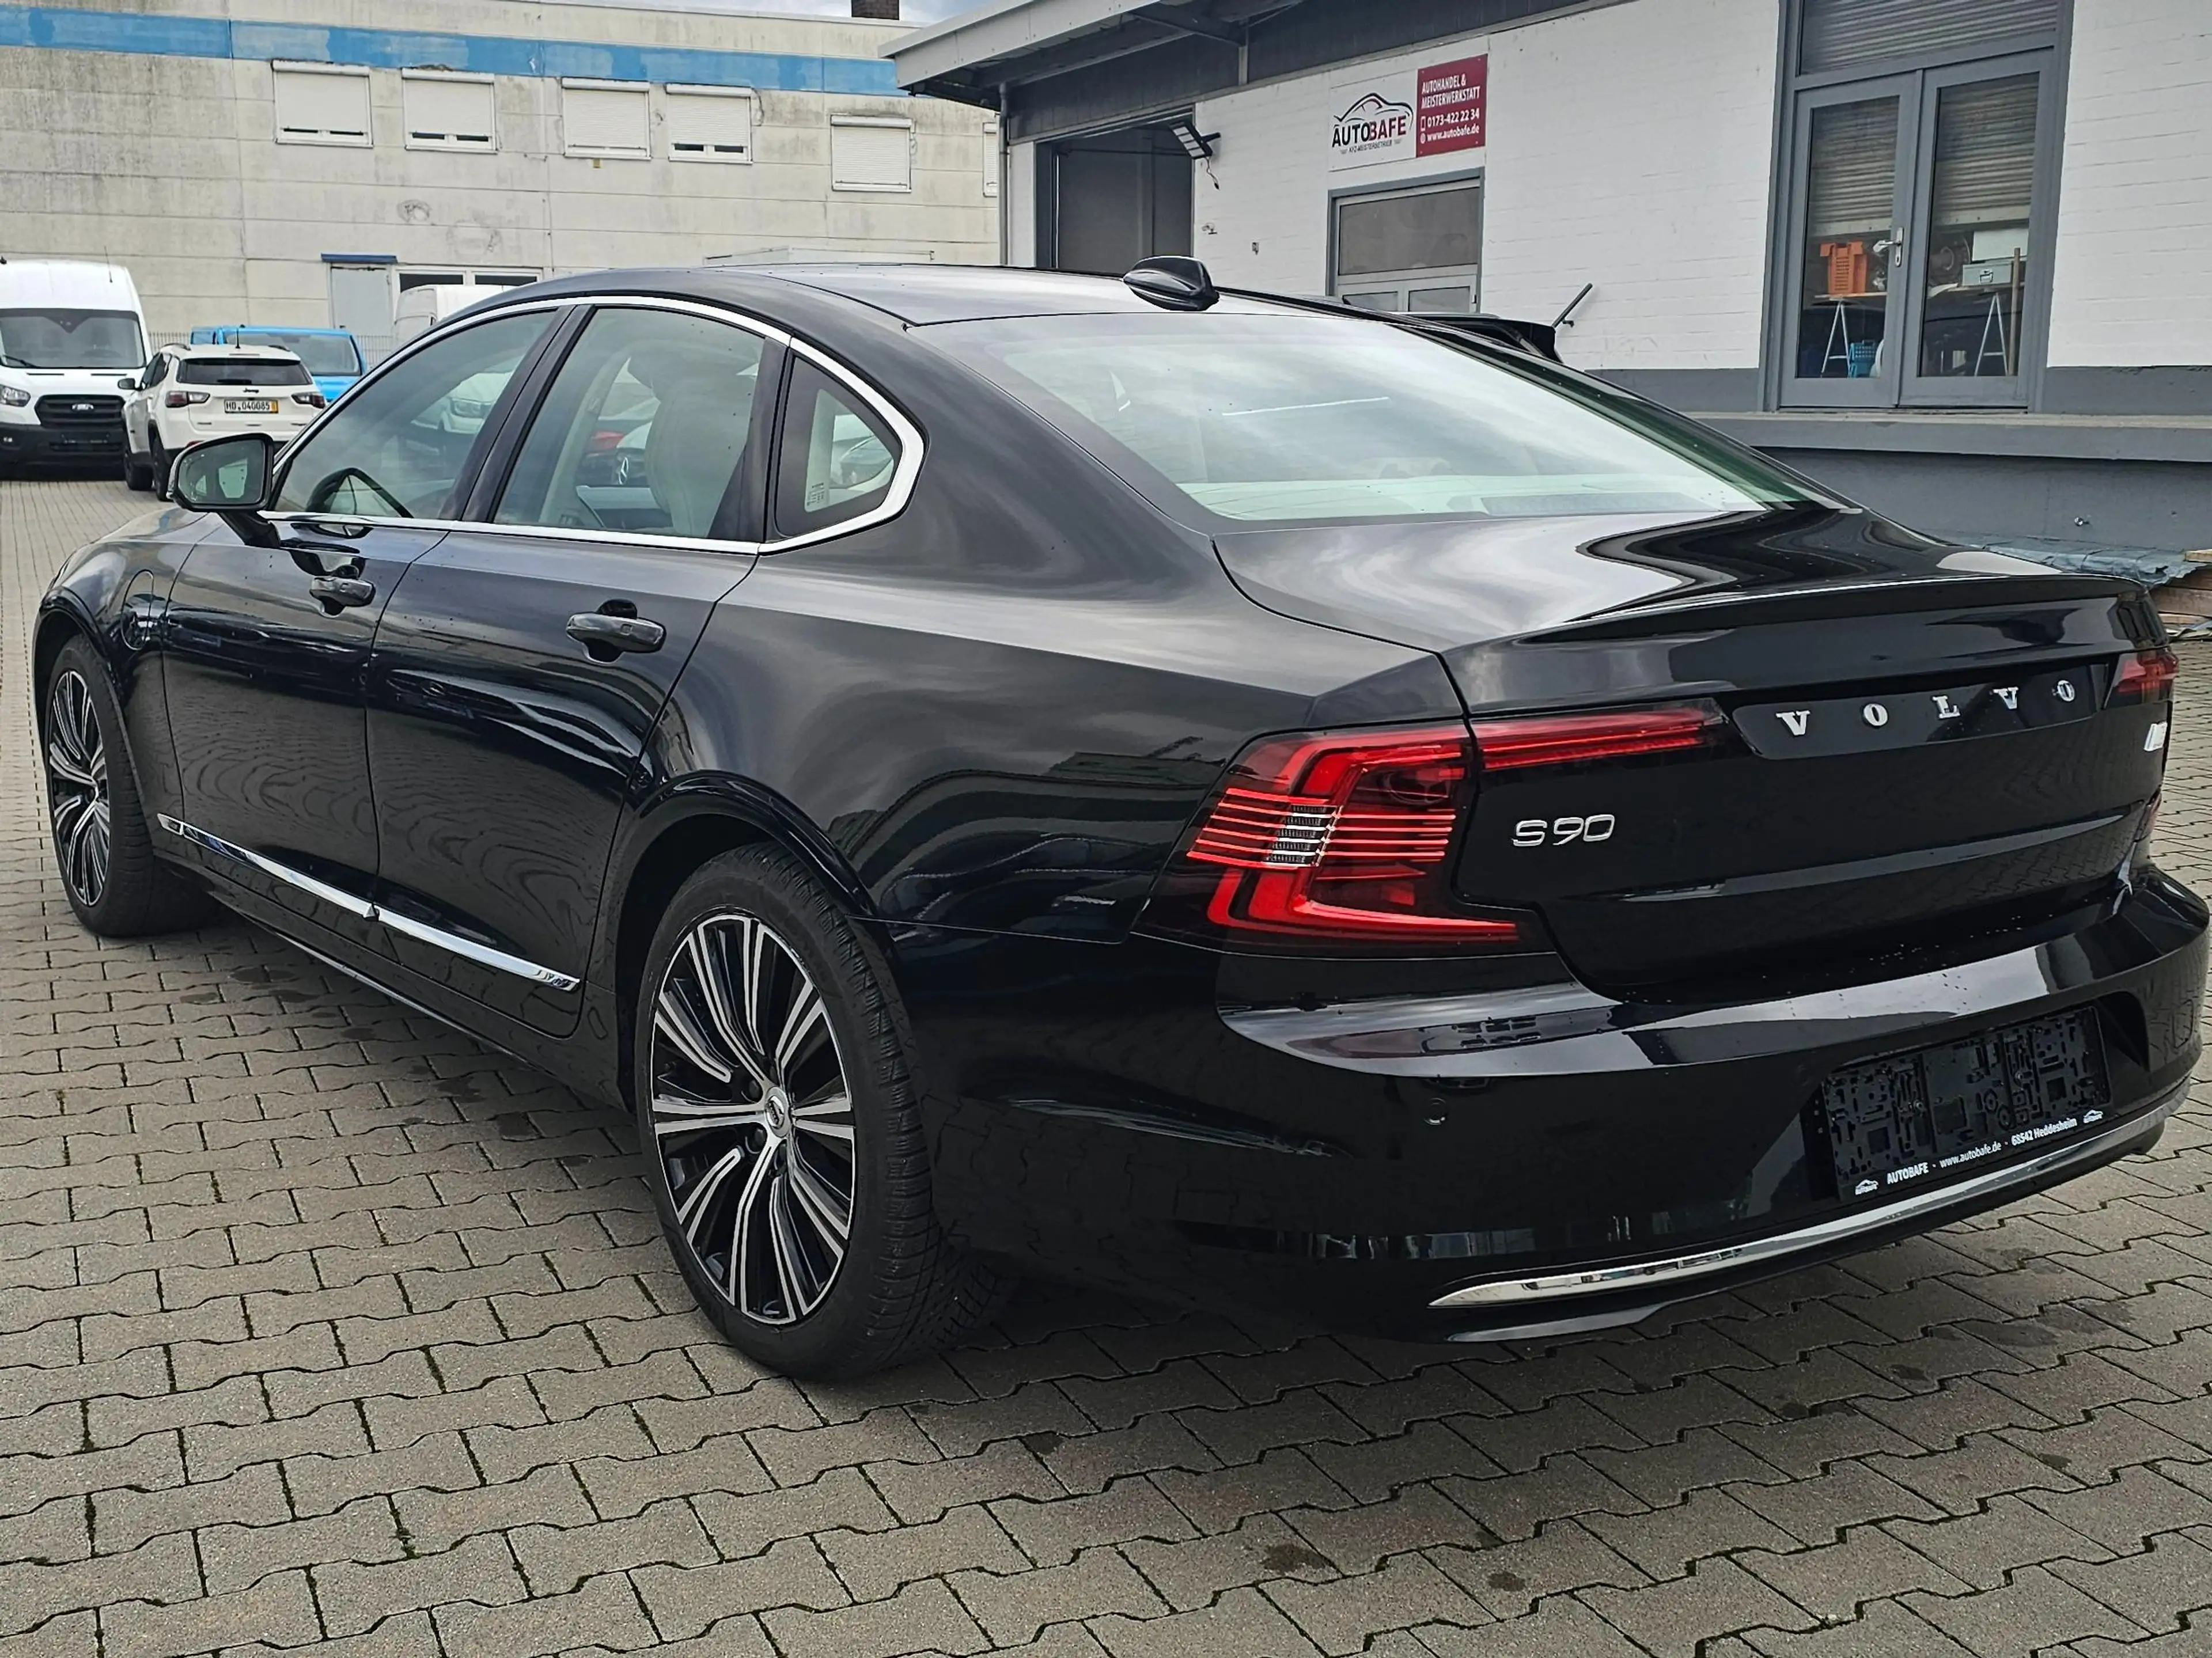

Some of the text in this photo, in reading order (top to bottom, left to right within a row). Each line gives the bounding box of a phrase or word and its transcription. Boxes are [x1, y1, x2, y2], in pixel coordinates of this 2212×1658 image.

[1422, 73, 1467, 94] AUTOHANDEL &
[1421, 86, 1480, 109] MEISTERWERKSTATT
[1332, 115, 1407, 147] AUTOBAFE
[1427, 108, 1480, 128] 0173-422 22 34
[1427, 123, 1480, 142] www.autobafe.de
[1775, 680, 2075, 736] VOLVO
[1512, 814, 1615, 847] S90
[1887, 1162, 1929, 1185] AUTOBAFE
[1939, 1141, 2002, 1168] www.autobafe.de
[2033, 1117, 2078, 1139] Heddesheim
